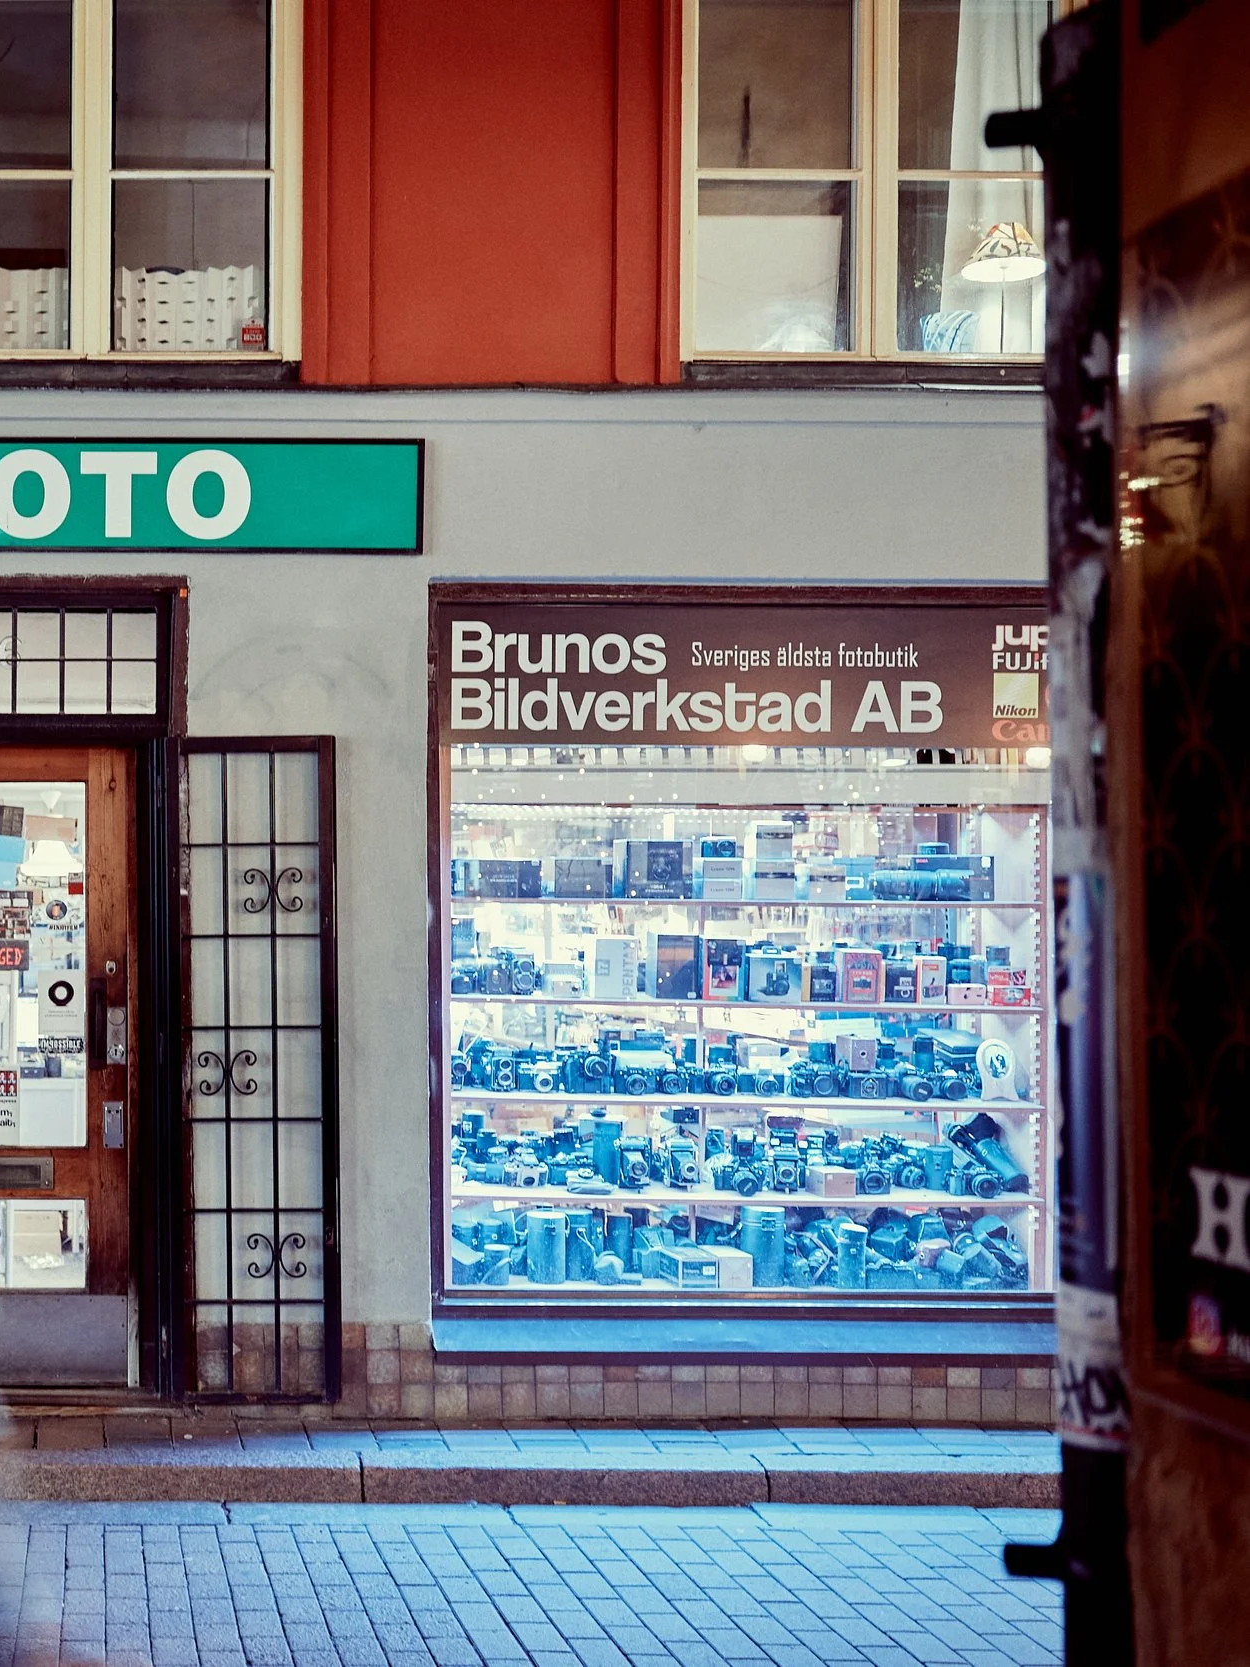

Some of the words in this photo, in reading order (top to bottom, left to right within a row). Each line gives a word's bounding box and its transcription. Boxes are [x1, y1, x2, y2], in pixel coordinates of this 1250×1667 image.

[451, 621, 666, 675] Brunos
[992, 625, 1050, 651] jup
[691, 641, 771, 671] Sveriges
[777, 642, 832, 668] äldsta
[838, 642, 919, 668] fotobutik
[451, 678, 832, 733] Bildverkstad
[851, 681, 943, 734] AB
[995, 705, 1037, 717] Nikon
